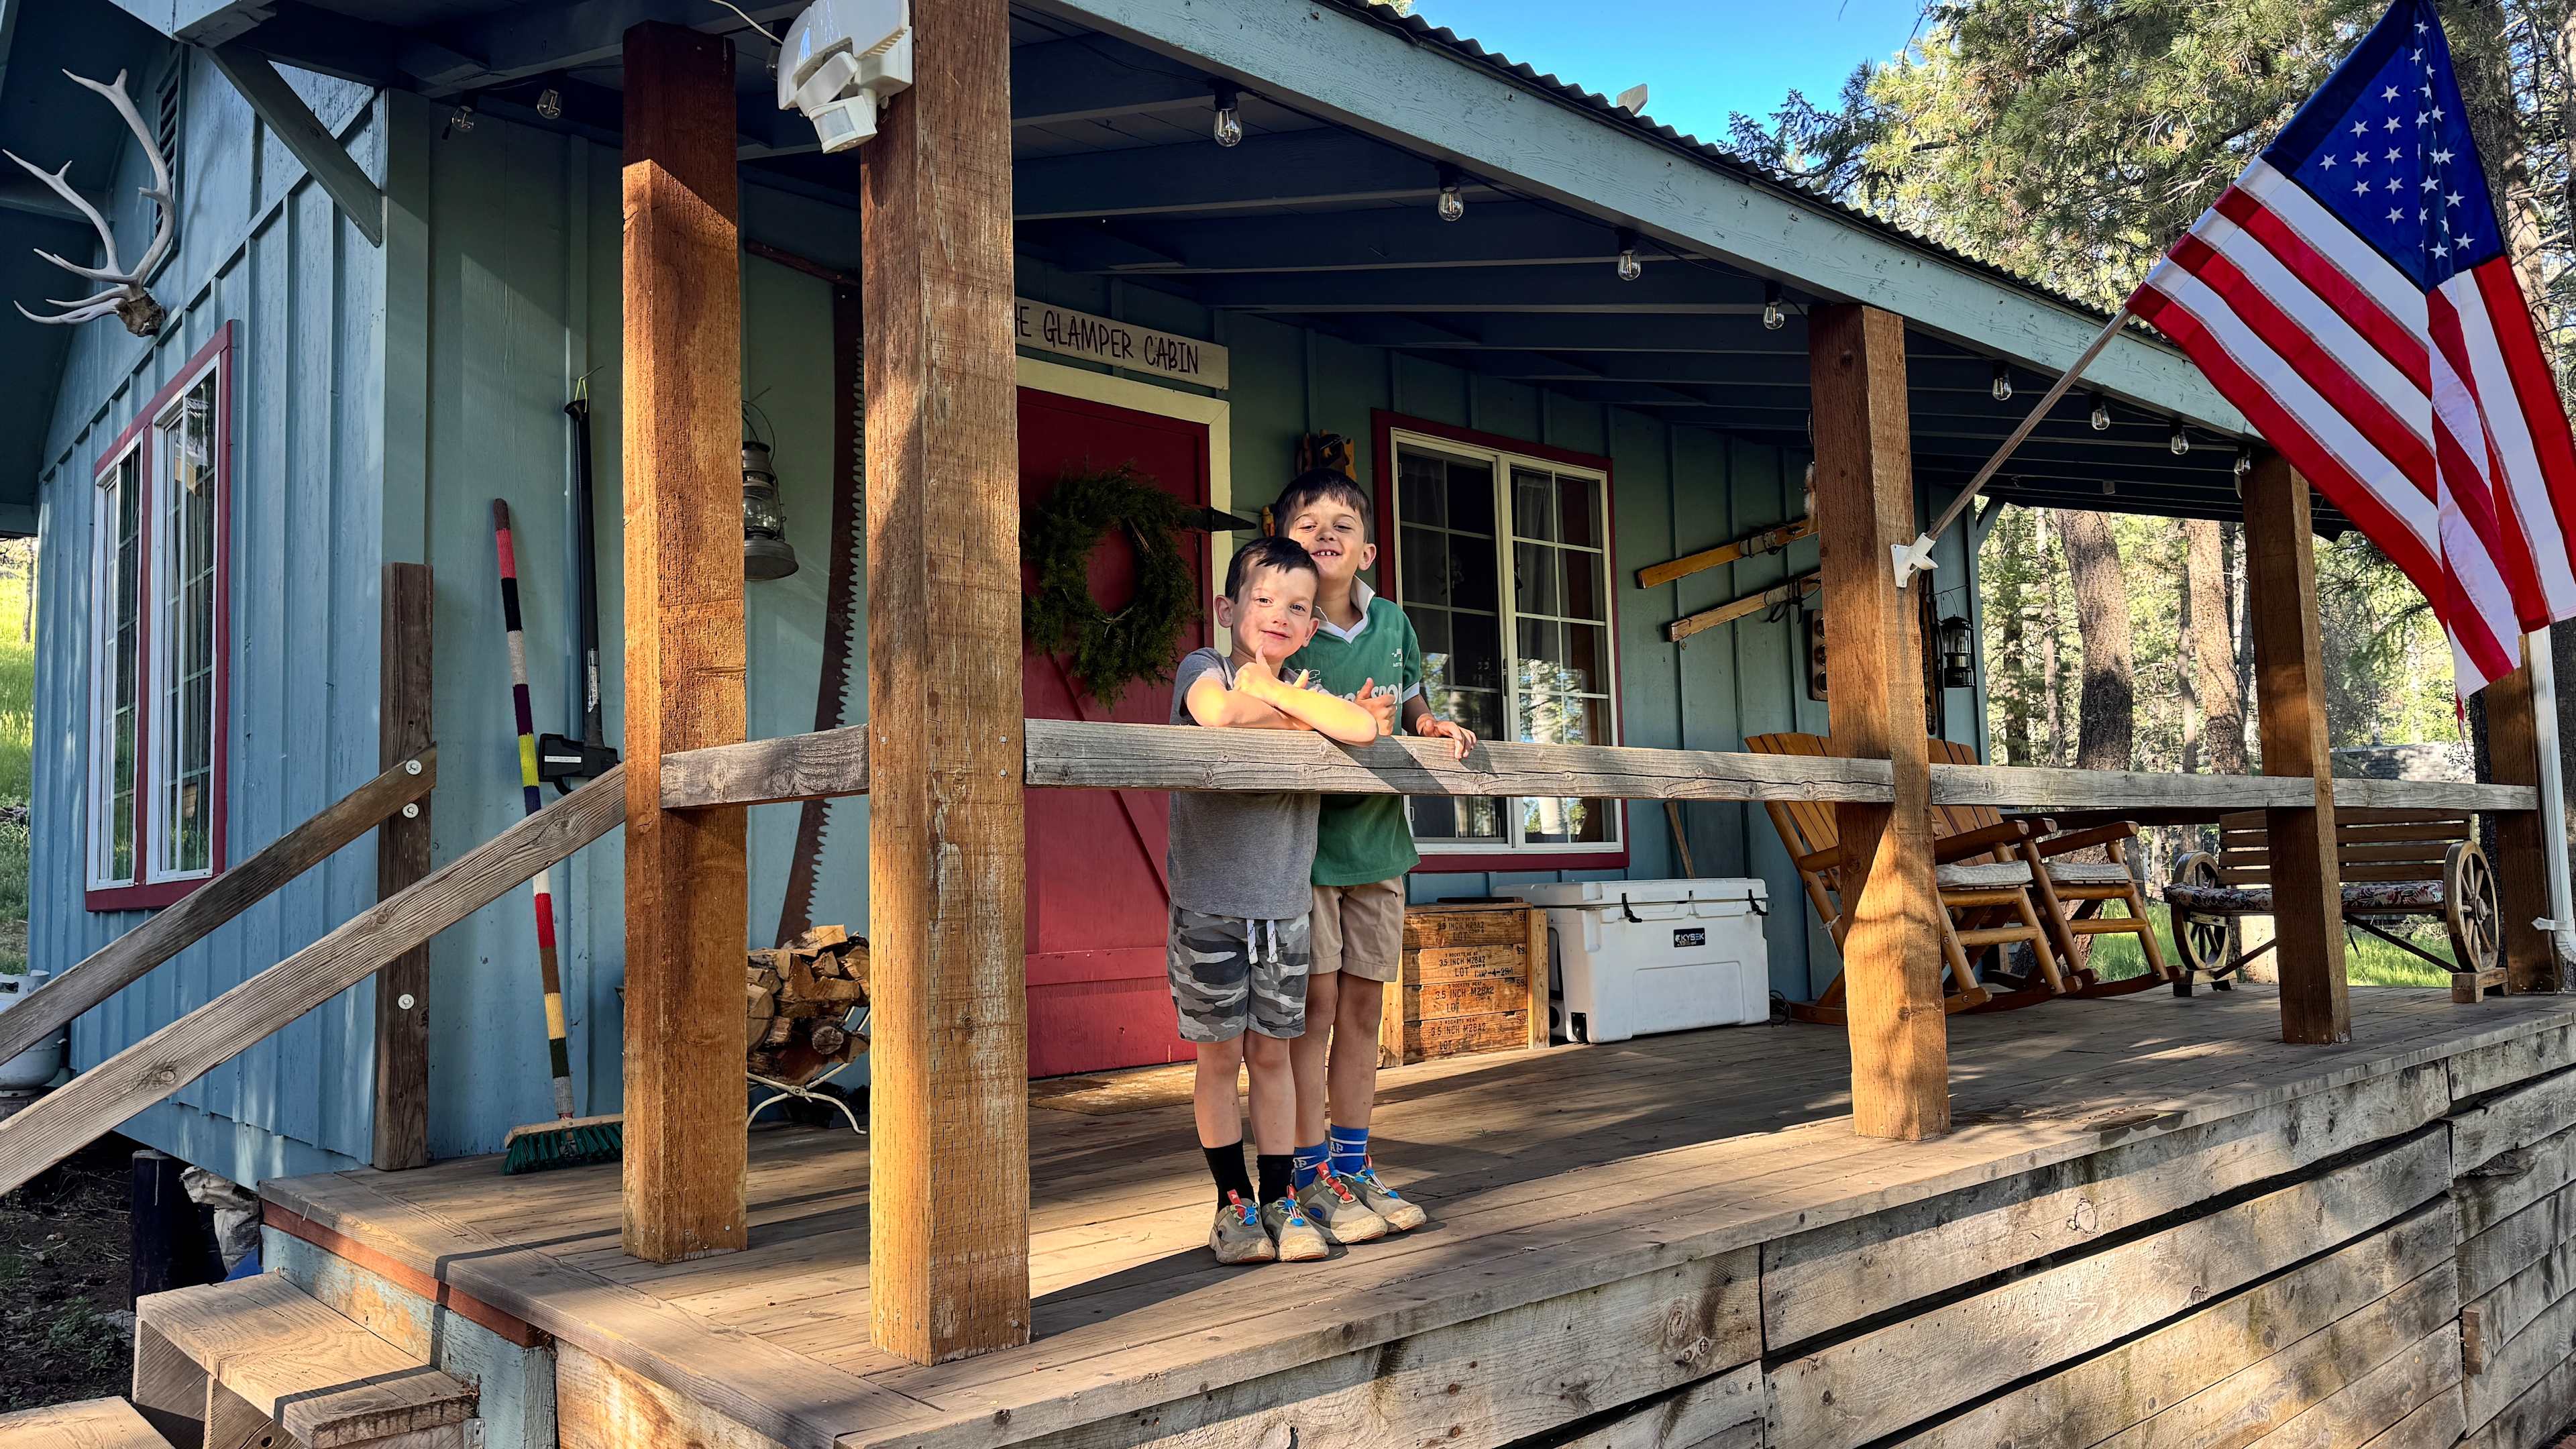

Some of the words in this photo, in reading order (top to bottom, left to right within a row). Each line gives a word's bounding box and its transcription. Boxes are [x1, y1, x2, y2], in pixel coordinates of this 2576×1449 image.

[1043, 310, 1134, 360] GLAMPER
[1144, 335, 1199, 374] CABIN
[1453, 931, 1468, 941] LOT
[1680, 932, 1705, 942] KYSEK
[1450, 957, 1464, 966] INCH
[1454, 966, 1469, 977] LOT
[1435, 989, 1446, 1000] 3.5
[1450, 987, 1466, 999] INCH
[1446, 1003, 1460, 1013] LOT
[1431, 1026, 1442, 1036] 3.5
[1444, 1024, 1460, 1035] INCH
[1440, 1040, 1452, 1050] LOT
